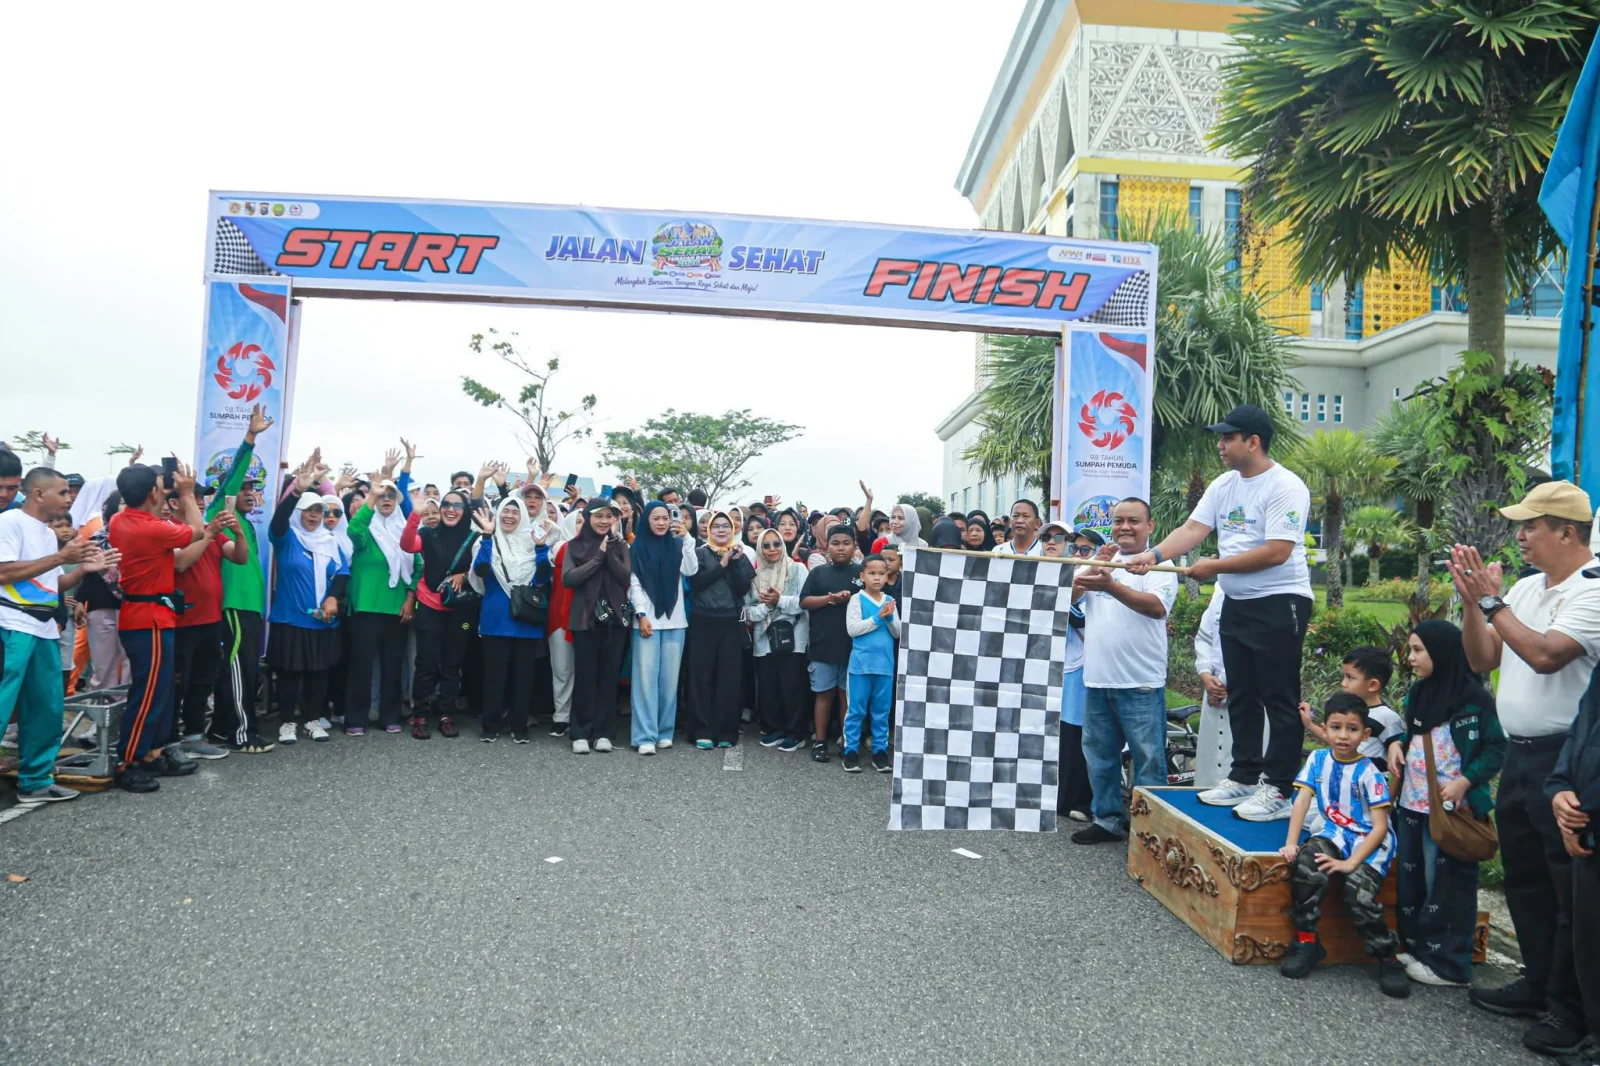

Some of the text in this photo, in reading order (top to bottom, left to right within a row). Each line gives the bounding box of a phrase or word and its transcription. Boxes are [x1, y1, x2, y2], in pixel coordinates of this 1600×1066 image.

[275, 228, 500, 274] START
[545, 235, 826, 275] JALAN SEHAT
[863, 258, 1091, 312] FINISH
[1075, 461, 1106, 469] SUMPAH
